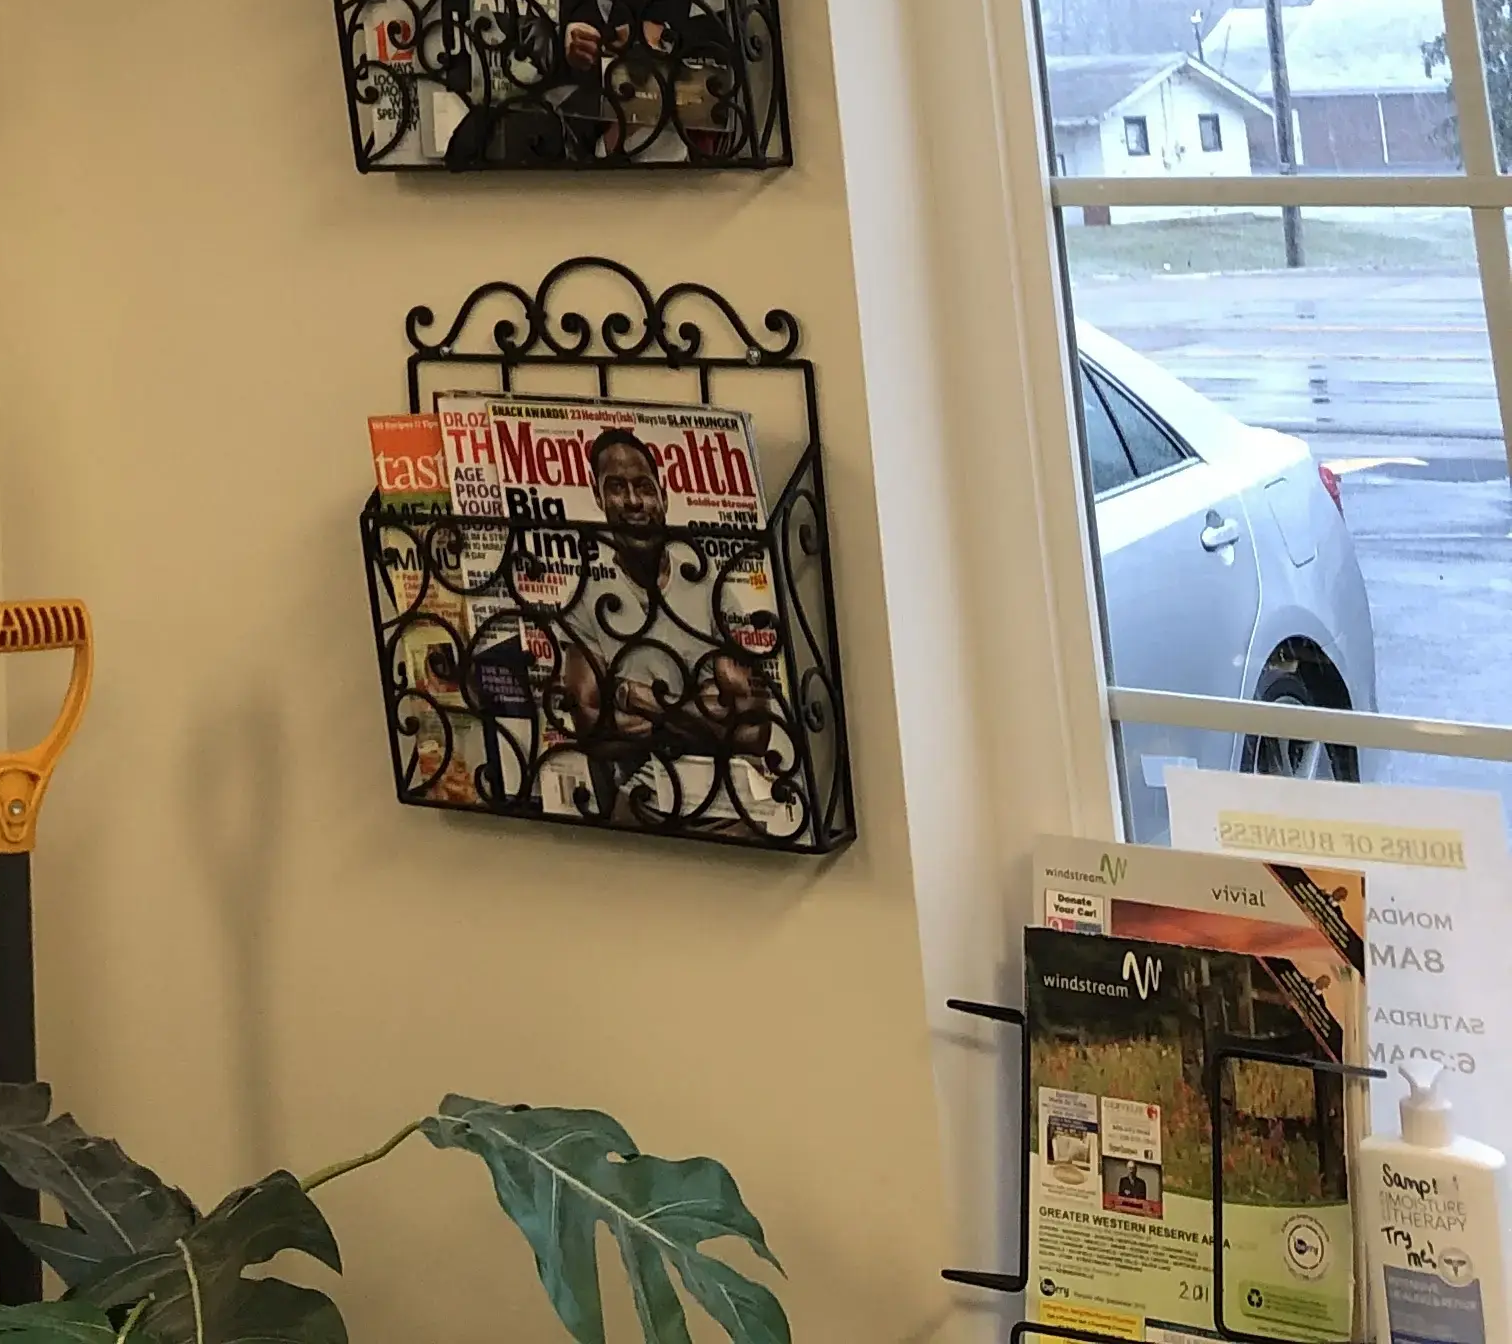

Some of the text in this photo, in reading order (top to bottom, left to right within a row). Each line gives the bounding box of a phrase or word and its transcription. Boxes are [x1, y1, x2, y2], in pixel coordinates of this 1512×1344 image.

[374, 19, 414, 63] 12
[491, 405, 523, 417] SNACK
[667, 415, 692, 428] SLAY
[693, 417, 739, 431] HUNGER
[376, 450, 450, 490] tast
[600, 425, 756, 498] ealth
[453, 466, 485, 482] AGE
[457, 499, 504, 516] YOUR
[505, 486, 566, 523] Big
[717, 510, 759, 524] THE NEW
[516, 561, 616, 582] Brkthroghs
[714, 559, 765, 574] WRKOUT
[730, 629, 776, 647] aradise
[1045, 865, 1107, 886] windstream
[1057, 892, 1092, 907] Donate
[1211, 885, 1266, 908] vivial
[1053, 903, 1075, 916] Your
[1043, 972, 1129, 999] windstream
[1389, 1192, 1467, 1216] MOISTURE
[1039, 1206, 1231, 1250] GREATER WESTERN RESERVE ARA
[1392, 1208, 1468, 1232] THERAPY
[1381, 1225, 1413, 1249] Try
